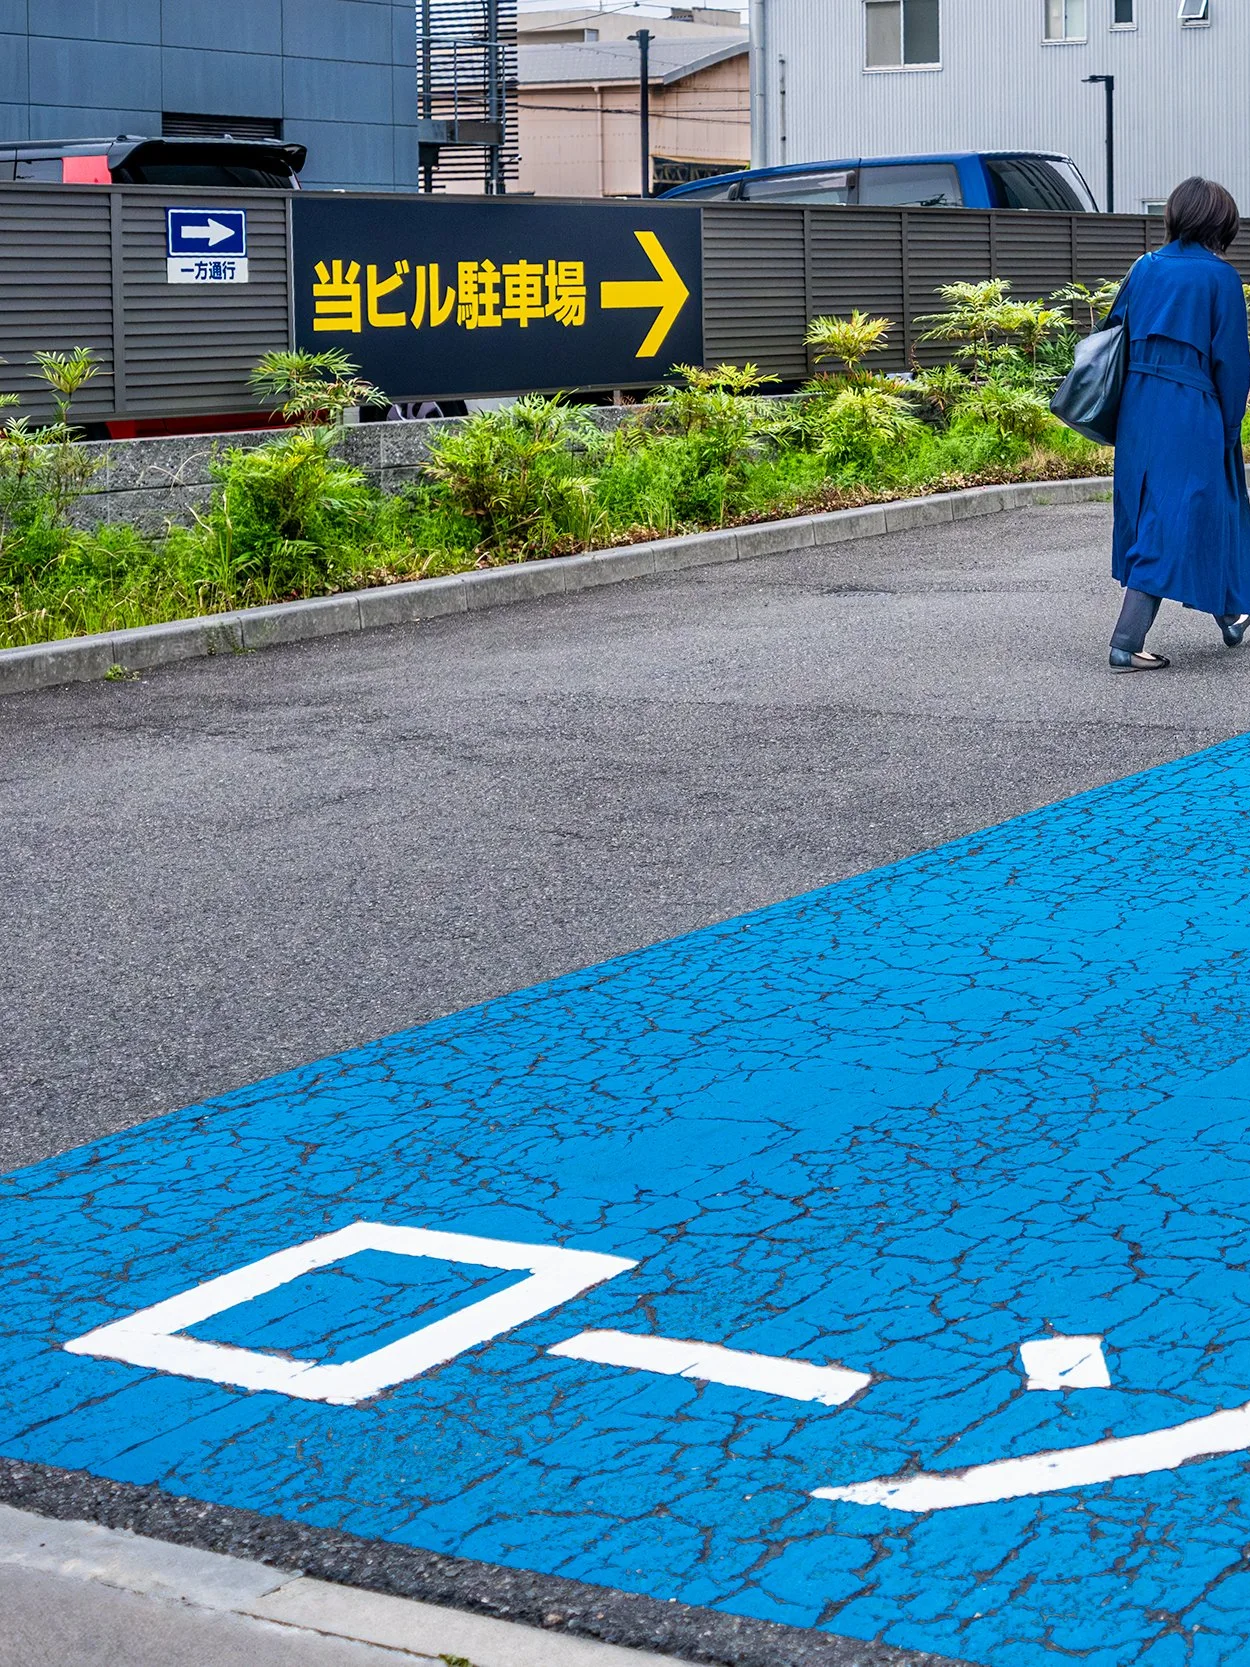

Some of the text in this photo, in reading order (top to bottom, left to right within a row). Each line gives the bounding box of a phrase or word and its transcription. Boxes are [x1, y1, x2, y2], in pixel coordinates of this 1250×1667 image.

[180, 261, 236, 280] 一方通行
[312, 259, 587, 333] 当ビル駐車場
